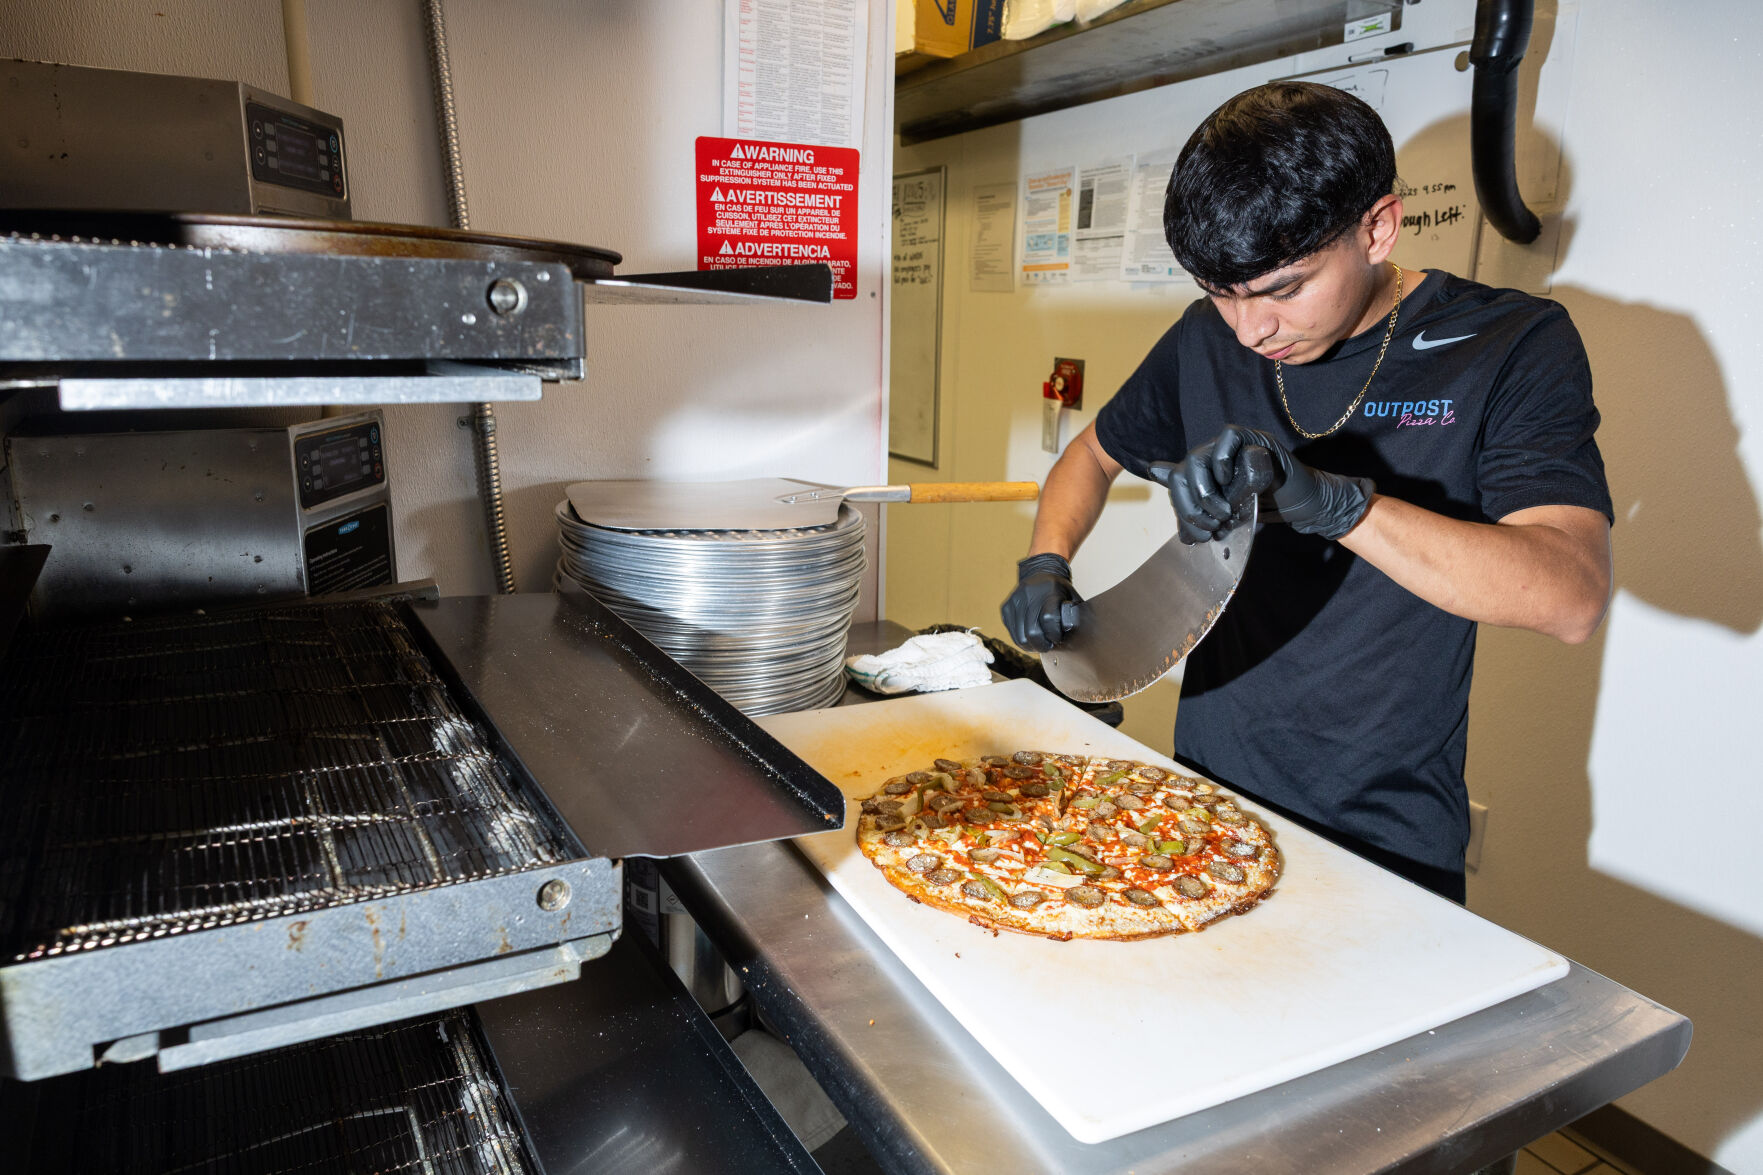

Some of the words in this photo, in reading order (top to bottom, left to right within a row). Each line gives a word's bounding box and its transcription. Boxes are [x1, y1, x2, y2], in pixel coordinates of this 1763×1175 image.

[745, 145, 814, 164] WARNING
[720, 168, 772, 178] EXTINGUISHER
[773, 171, 792, 179] ONLY
[721, 160, 741, 168] CASE
[754, 162, 793, 172] APPLIANCE
[795, 165, 812, 173] FIRE,
[700, 174, 751, 184] SUPPRESSION
[753, 178, 780, 186] SYSTEM
[818, 182, 854, 191] ACTUATED
[726, 189, 842, 208] AVERTISSEMENT
[716, 212, 750, 220] CUISSON,
[798, 216, 839, 224] EXTINCTEUR
[716, 219, 758, 228] SEULEMENT
[1402, 211, 1430, 236] ough
[771, 230, 813, 238] PROTECTION
[815, 231, 847, 240] INCENDIE.
[735, 242, 830, 258] ADVERTENCIA
[1364, 400, 1453, 417] OUTPOST
[1397, 414, 1436, 428] Pizza
